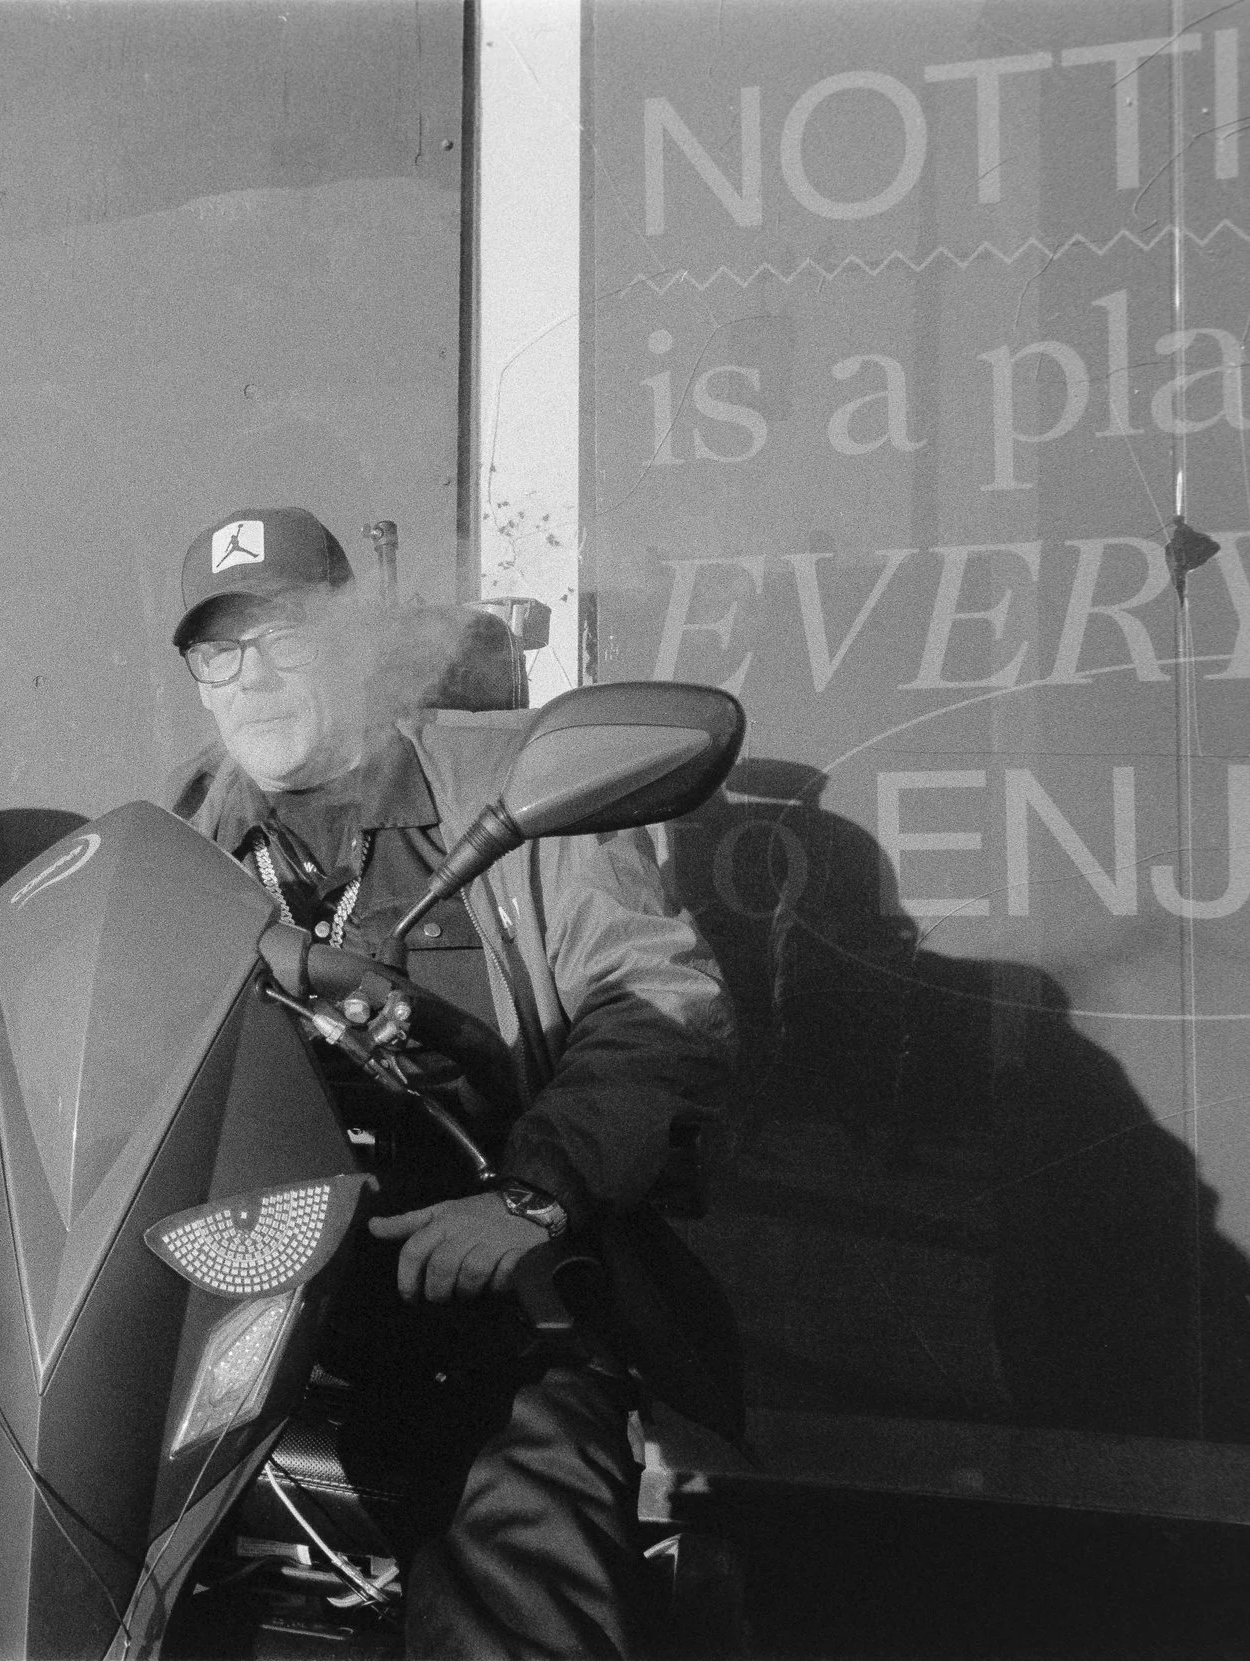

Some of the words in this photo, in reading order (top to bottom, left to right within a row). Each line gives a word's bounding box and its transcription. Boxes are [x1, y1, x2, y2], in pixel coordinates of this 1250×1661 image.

[644, 27, 1240, 236] NOTTI
[639, 328, 769, 467] is
[826, 352, 929, 456] a
